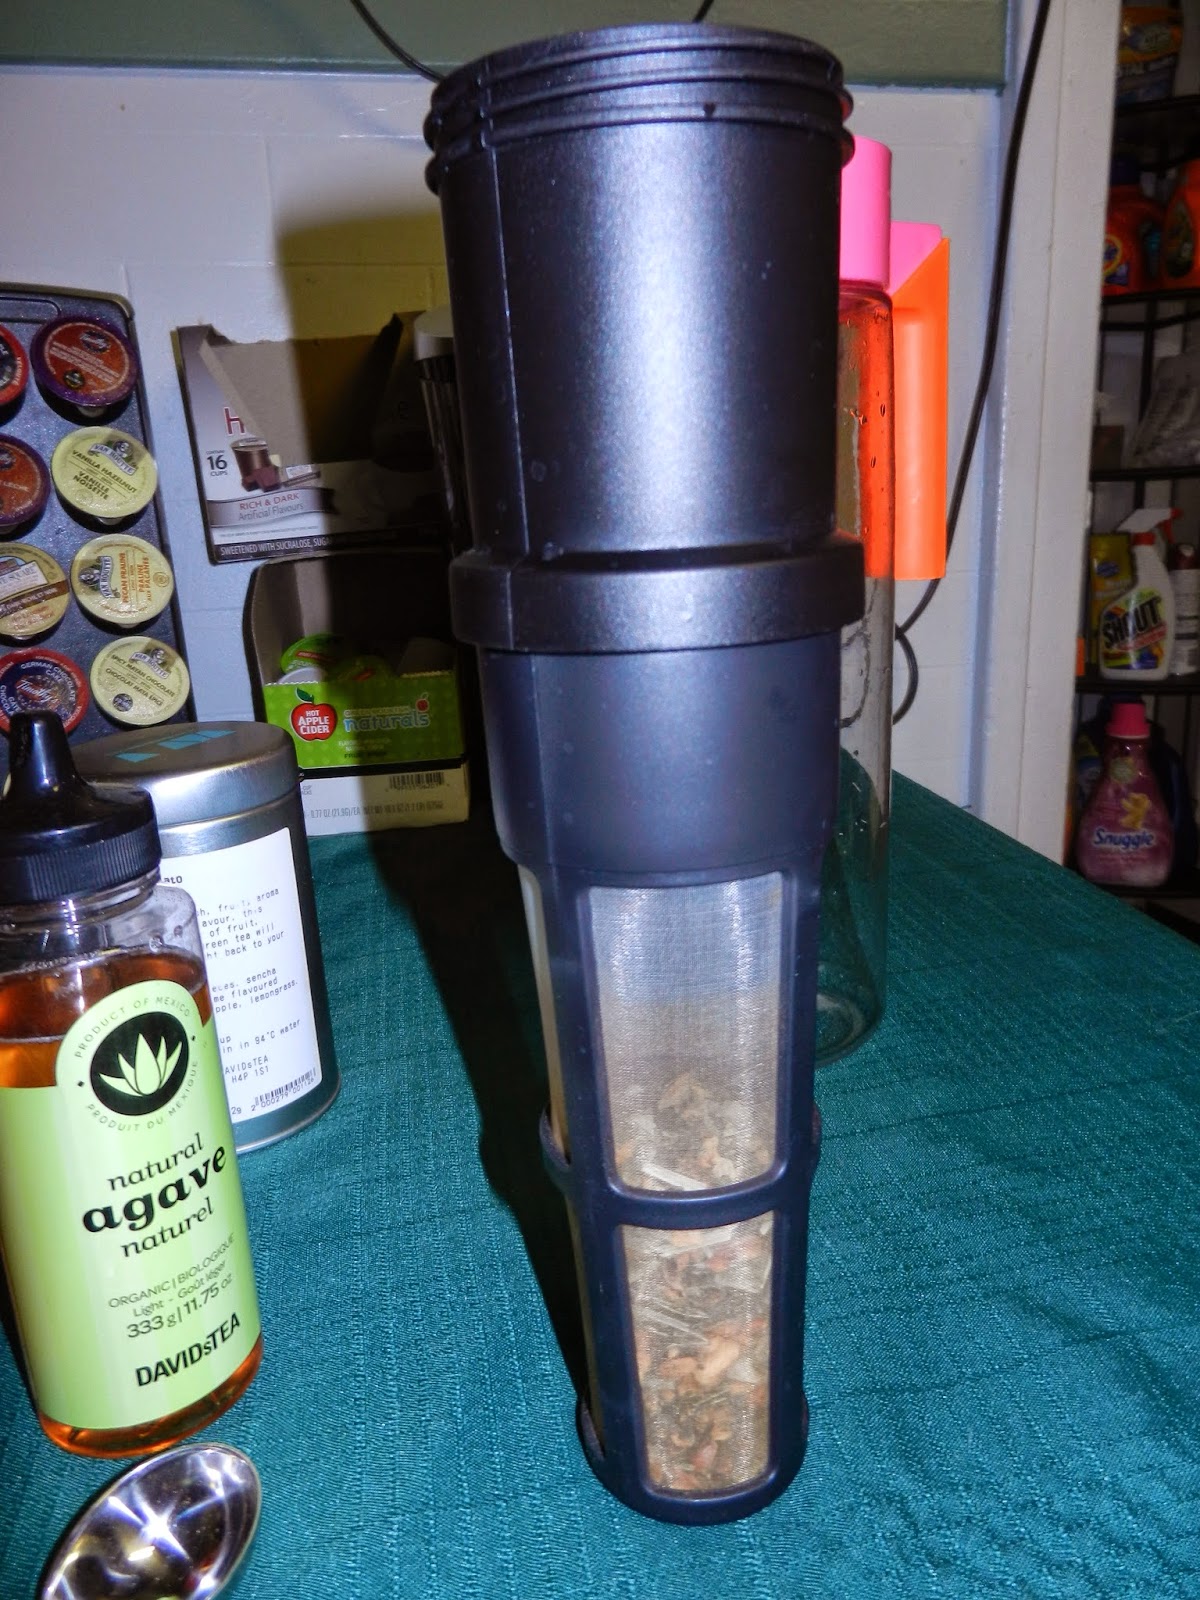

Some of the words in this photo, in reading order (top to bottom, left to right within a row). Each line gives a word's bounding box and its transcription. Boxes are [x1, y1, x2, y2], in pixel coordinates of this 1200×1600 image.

[94, 444, 111, 457] VAN
[109, 450, 135, 475] HOUTTE
[206, 454, 228, 470] 16
[72, 450, 101, 469] VANILLA
[101, 467, 138, 494] HAZELNUT
[78, 470, 110, 494] VANILLE
[73, 475, 109, 500] NOISETTE
[239, 501, 262, 511] RICH
[264, 499, 271, 507] &
[273, 493, 299, 505] DARK
[239, 507, 271, 521] Artificial
[272, 503, 304, 516] Flavours
[220, 544, 258, 556] SWEETENED
[259, 542, 276, 552] WITH
[276, 539, 313, 551] SUCRALOSE,
[101, 557, 112, 583] HOUTTE
[118, 552, 128, 580] PRALINE
[137, 563, 146, 593] PRALINE
[100, 585, 112, 598] VAN
[121, 580, 129, 604] PECAN
[1102, 595, 1163, 650] SHOUT
[111, 654, 127, 665] SPICY
[145, 675, 176, 698] CHOCOLATE
[134, 652, 148, 660] VAN
[146, 658, 168, 678] HOUTTE
[20, 661, 53, 670] GERMAN
[53, 665, 77, 703] CHOCOLATE
[105, 667, 134, 688] CHOCOLAT
[298, 716, 330, 726] APPLE
[305, 709, 320, 717] HOT
[343, 711, 430, 733] naturals
[300, 725, 330, 735] CIDER
[323, 808, 332, 818] OZ
[1093, 826, 1155, 850] Snuggle
[256, 888, 280, 902] aroma
[209, 928, 220, 938] of
[225, 944, 247, 957] back
[253, 939, 263, 949] to
[267, 930, 285, 945] your
[235, 932, 251, 943] tea
[255, 922, 275, 937] will
[246, 967, 277, 984] sencha
[231, 977, 278, 999] flavoured
[74, 1006, 125, 1058] PRODUCT
[133, 998, 149, 1010] OF
[156, 996, 191, 1017] MEXICO
[239, 1041, 250, 1050] in
[280, 1019, 301, 1035] water
[231, 1074, 249, 1084] H4P
[254, 1065, 270, 1077] 1S1
[86, 1103, 140, 1132] PRODUIT
[147, 1116, 164, 1129] DU
[168, 1060, 199, 1117] MEXIQUE
[107, 1132, 205, 1191] natural
[82, 1146, 227, 1233] agave
[120, 1196, 215, 1258] naturel
[108, 1280, 171, 1308] ORGANIC
[177, 1233, 235, 1285] BIOLOGIQUE
[127, 1315, 165, 1338] 333
[183, 1282, 220, 1315] 11.75
[220, 1273, 234, 1289] oz
[132, 1299, 165, 1317] Light
[135, 1312, 241, 1387] DAVIDsTEA
